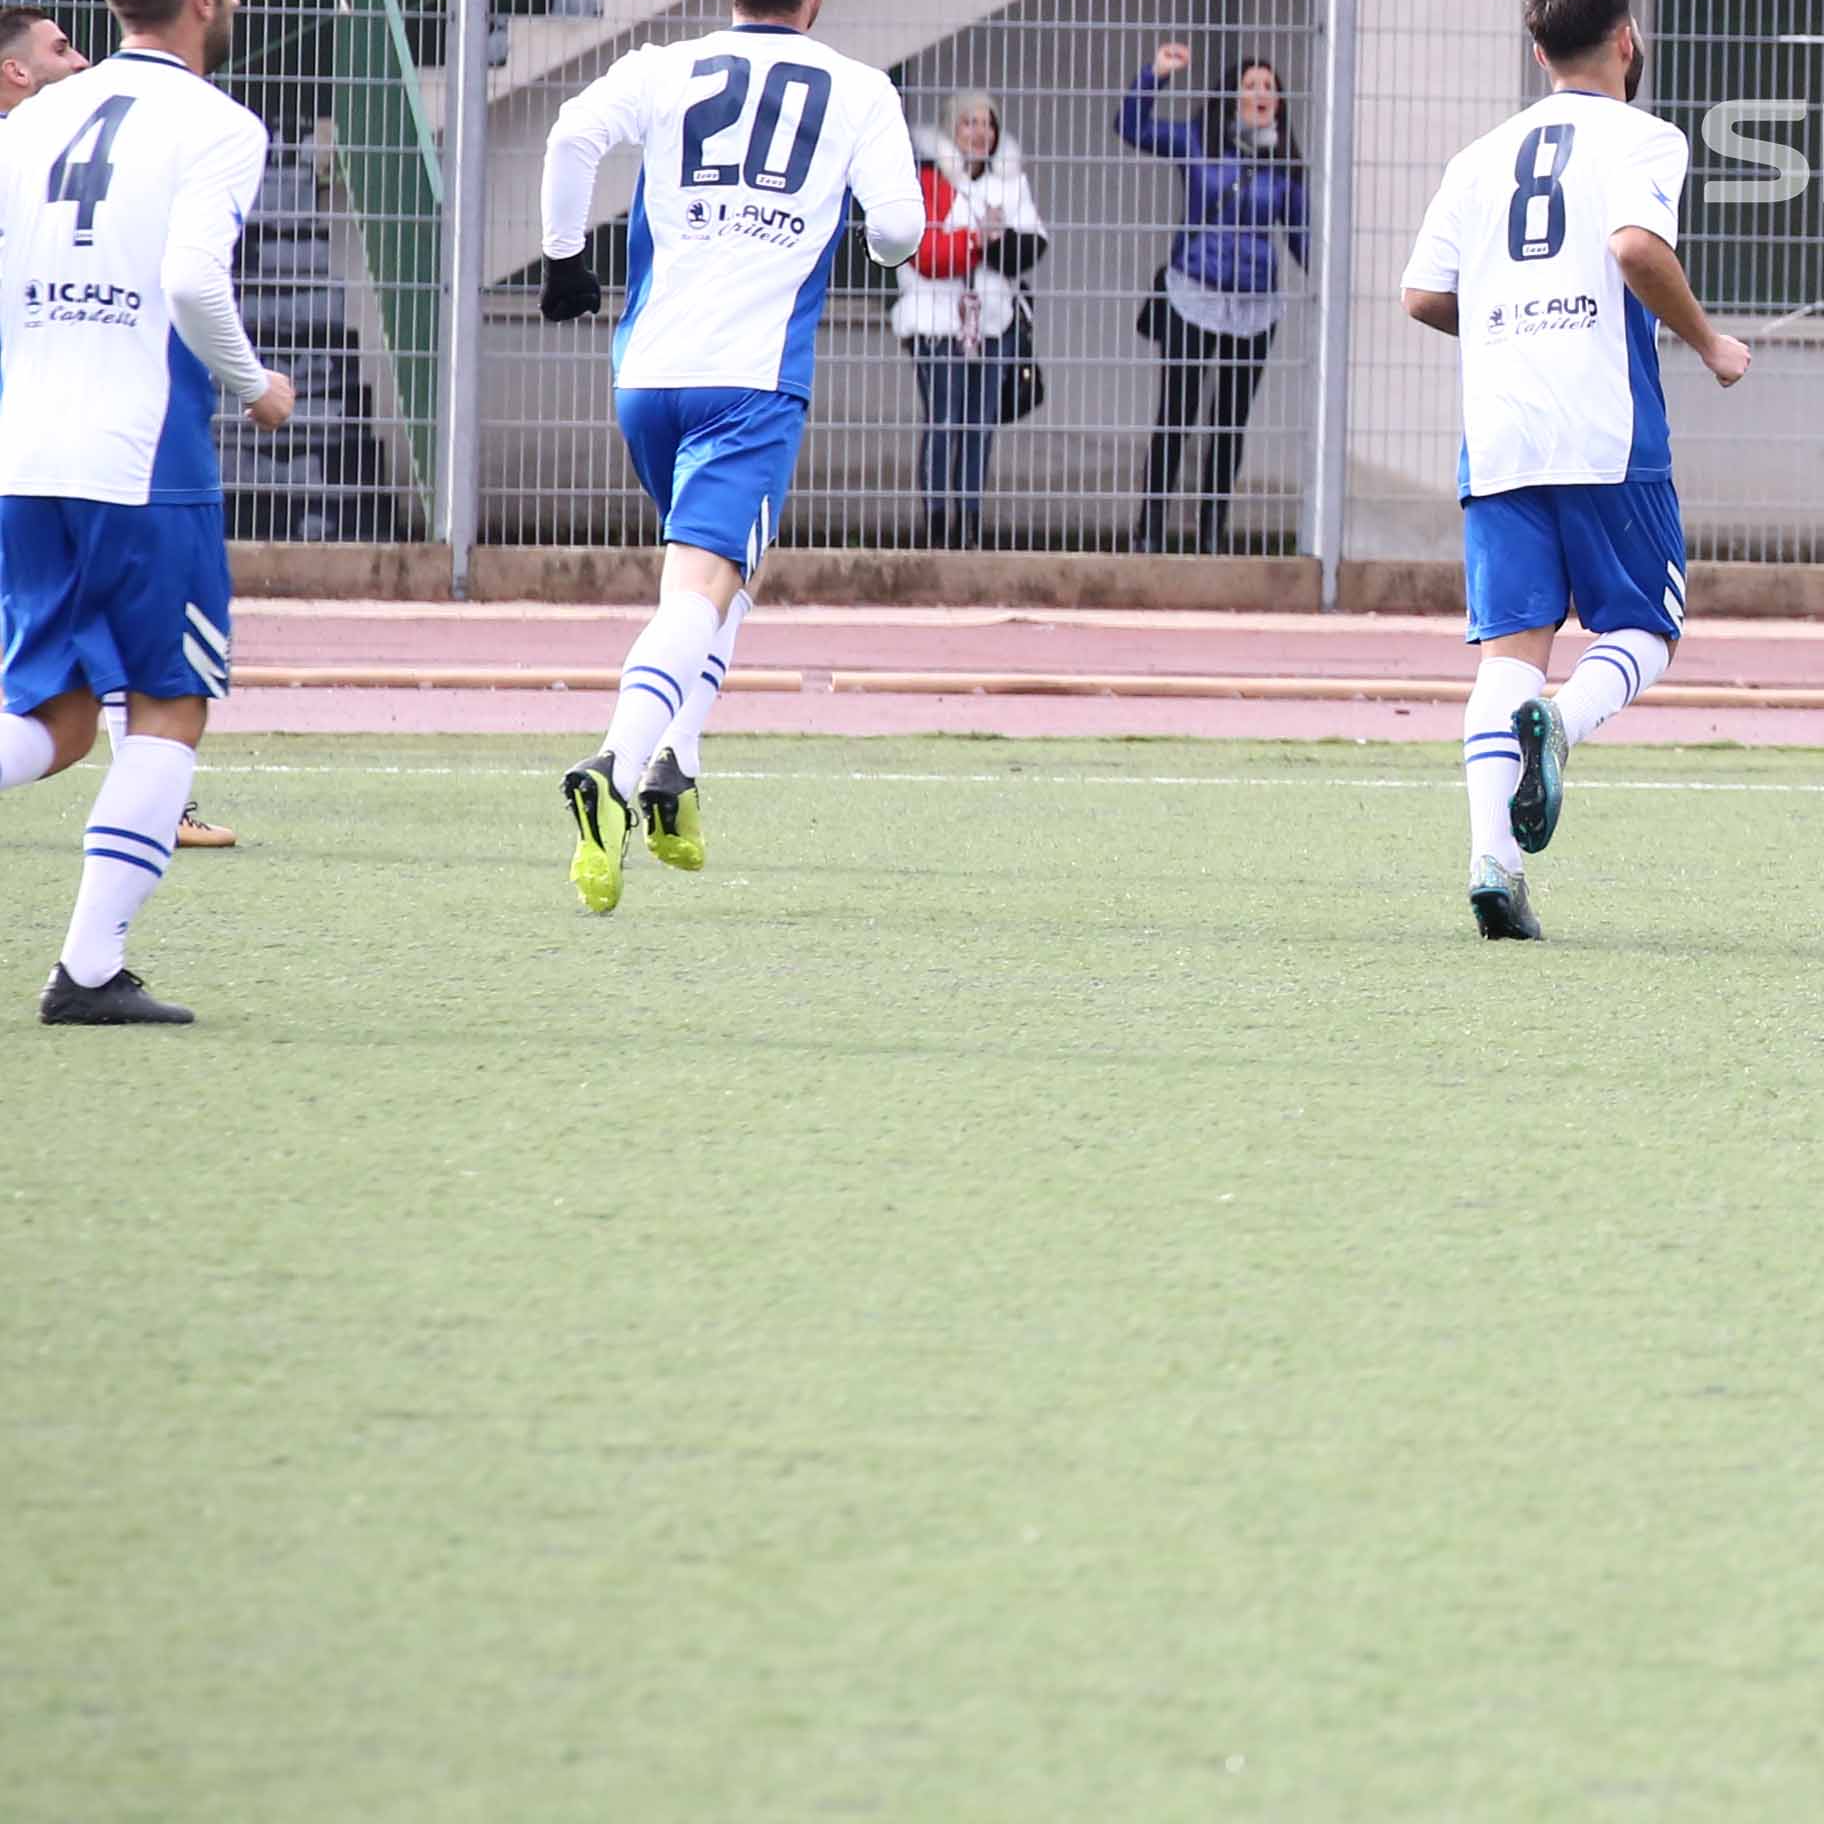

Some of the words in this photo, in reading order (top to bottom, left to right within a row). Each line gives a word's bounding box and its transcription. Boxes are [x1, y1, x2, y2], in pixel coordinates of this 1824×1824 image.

[47, 94, 137, 246] 4
[680, 54, 832, 194] 20
[1507, 123, 1576, 262] 8
